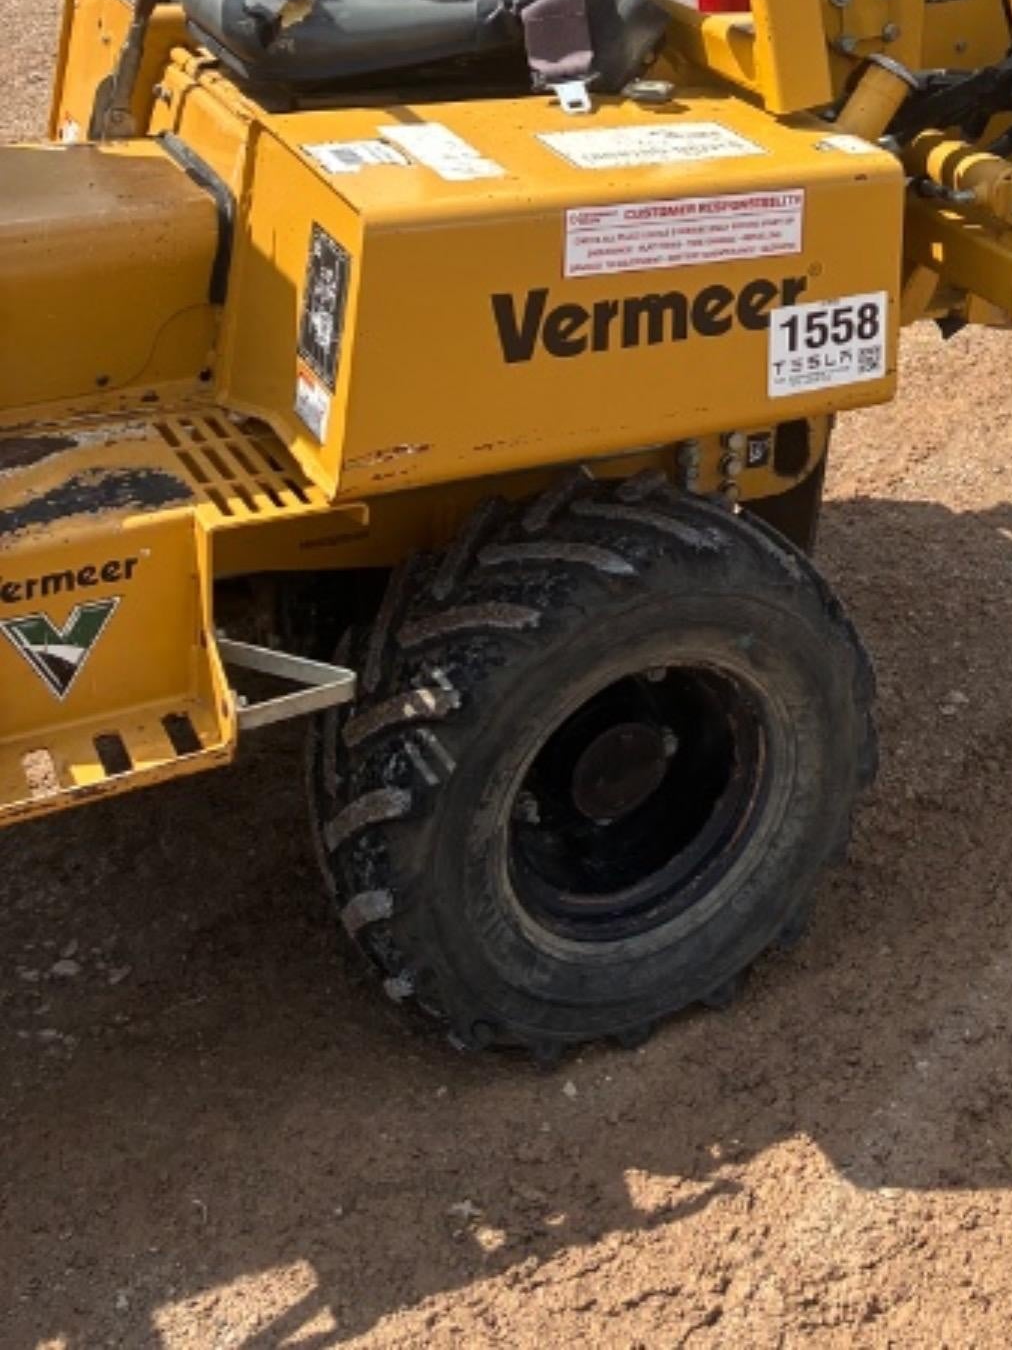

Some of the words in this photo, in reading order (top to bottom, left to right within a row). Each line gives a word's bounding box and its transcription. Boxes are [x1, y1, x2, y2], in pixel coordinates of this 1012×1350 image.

[491, 275, 807, 364] Vermeer
[780, 302, 880, 352] 1558
[773, 349, 852, 376] TESLA
[0, 557, 138, 603] ermeer
